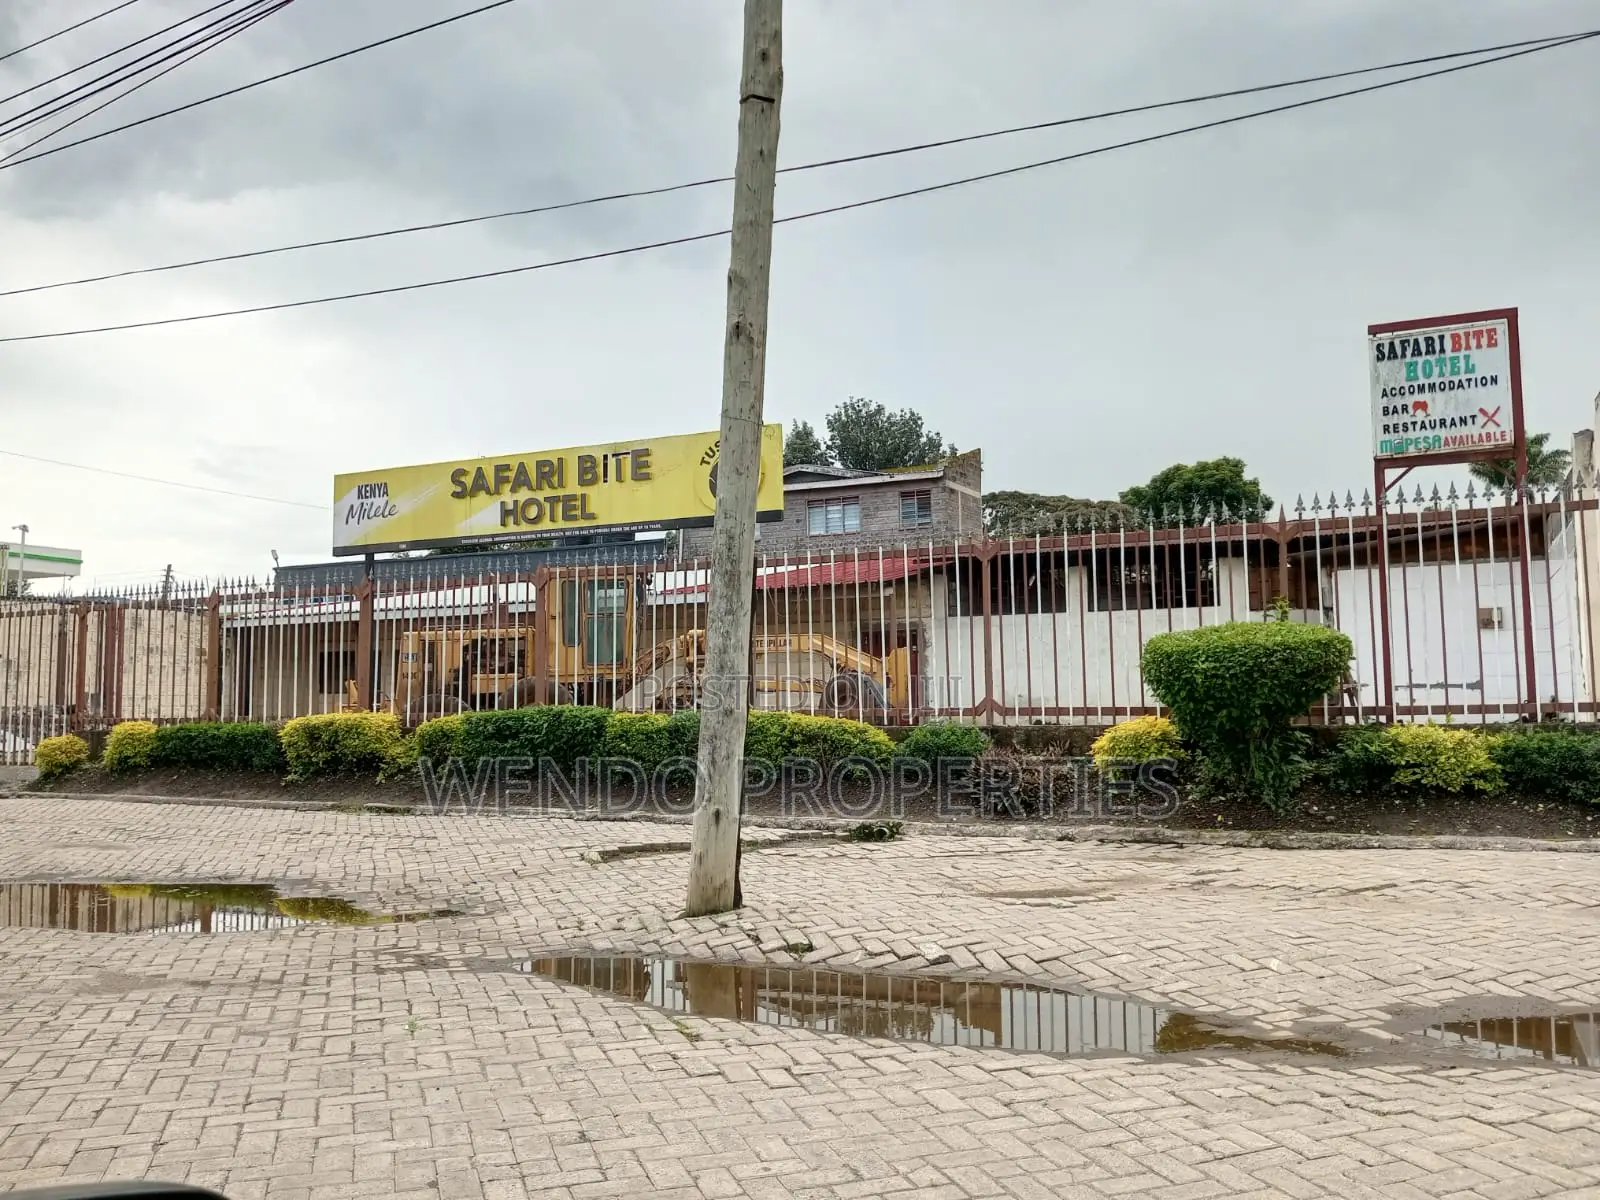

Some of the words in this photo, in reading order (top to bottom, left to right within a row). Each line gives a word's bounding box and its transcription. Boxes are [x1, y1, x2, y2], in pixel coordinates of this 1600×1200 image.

[1376, 334, 1446, 362] SAFARI
[1450, 327, 1498, 353] BITE
[1404, 354, 1476, 382] HOTEL
[1381, 374, 1499, 399] ACCOMMODATION
[1382, 403, 1410, 417] BAR
[1383, 414, 1478, 435] RESTAURANT
[1443, 430, 1508, 448] AVAILABLE
[450, 456, 566, 499] SAFARI
[577, 447, 653, 487] BITE
[357, 482, 389, 500] KENYA
[345, 500, 400, 526] Milele
[500, 492, 597, 527] HOTEL
